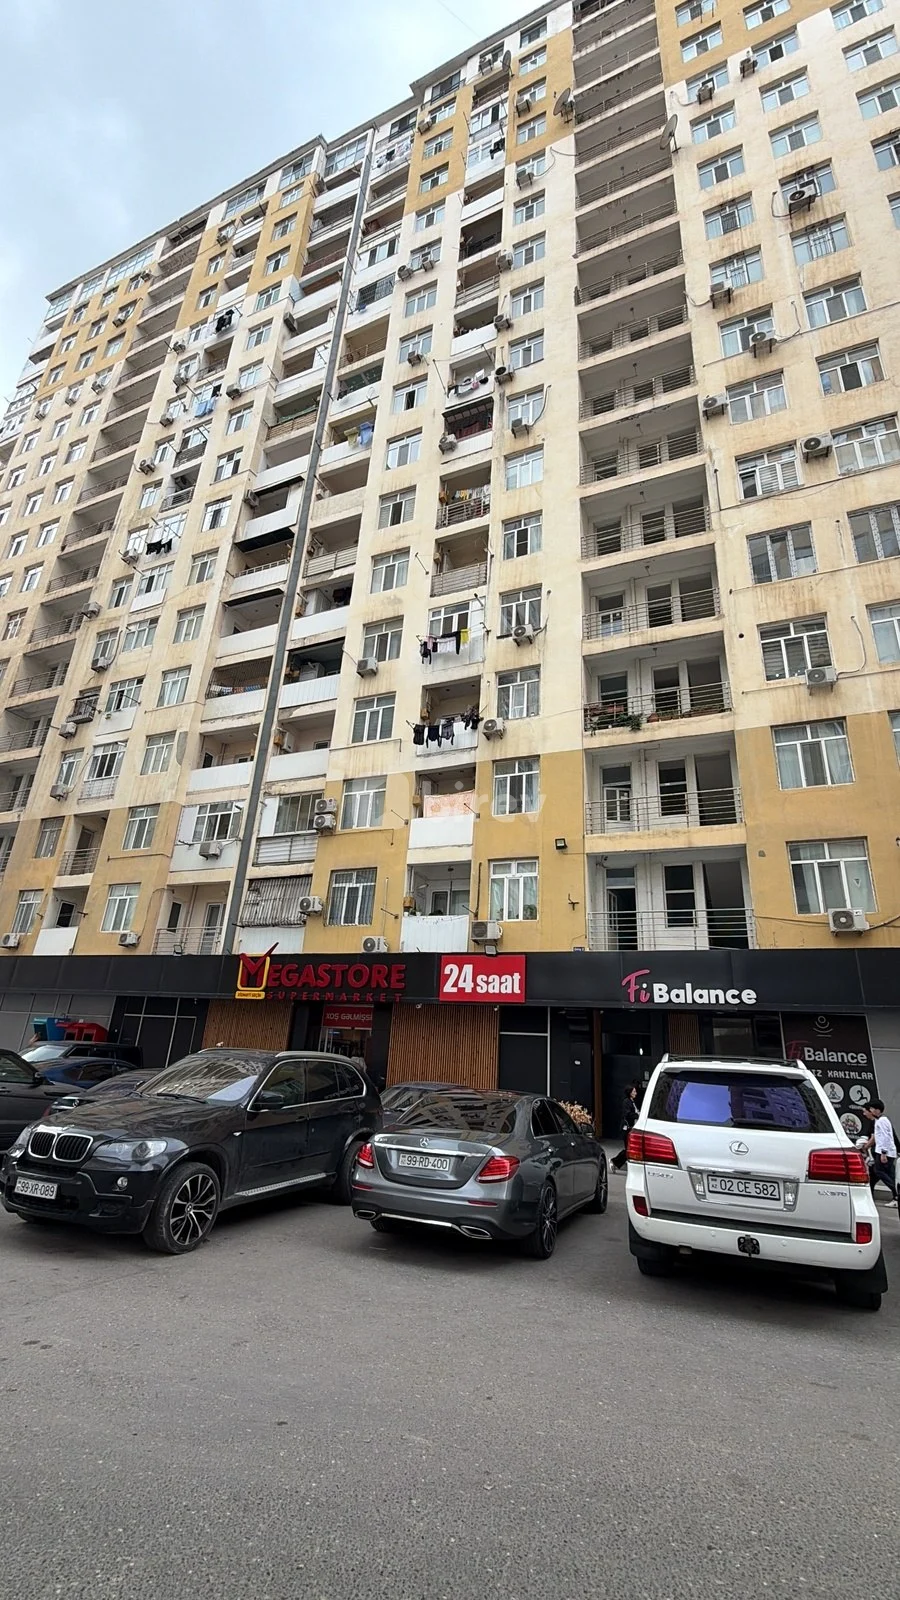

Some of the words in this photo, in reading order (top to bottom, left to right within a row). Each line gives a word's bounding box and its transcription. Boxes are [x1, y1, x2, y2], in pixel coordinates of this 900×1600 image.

[239, 942, 406, 989] MEGASTORE
[443, 964, 474, 993] 24
[476, 972, 521, 994] saat
[266, 991, 403, 1002] SUPERMARKET
[720, 1179, 734, 1192] 02
[736, 1181, 750, 1194] CE
[754, 1183, 777, 1197] 582
